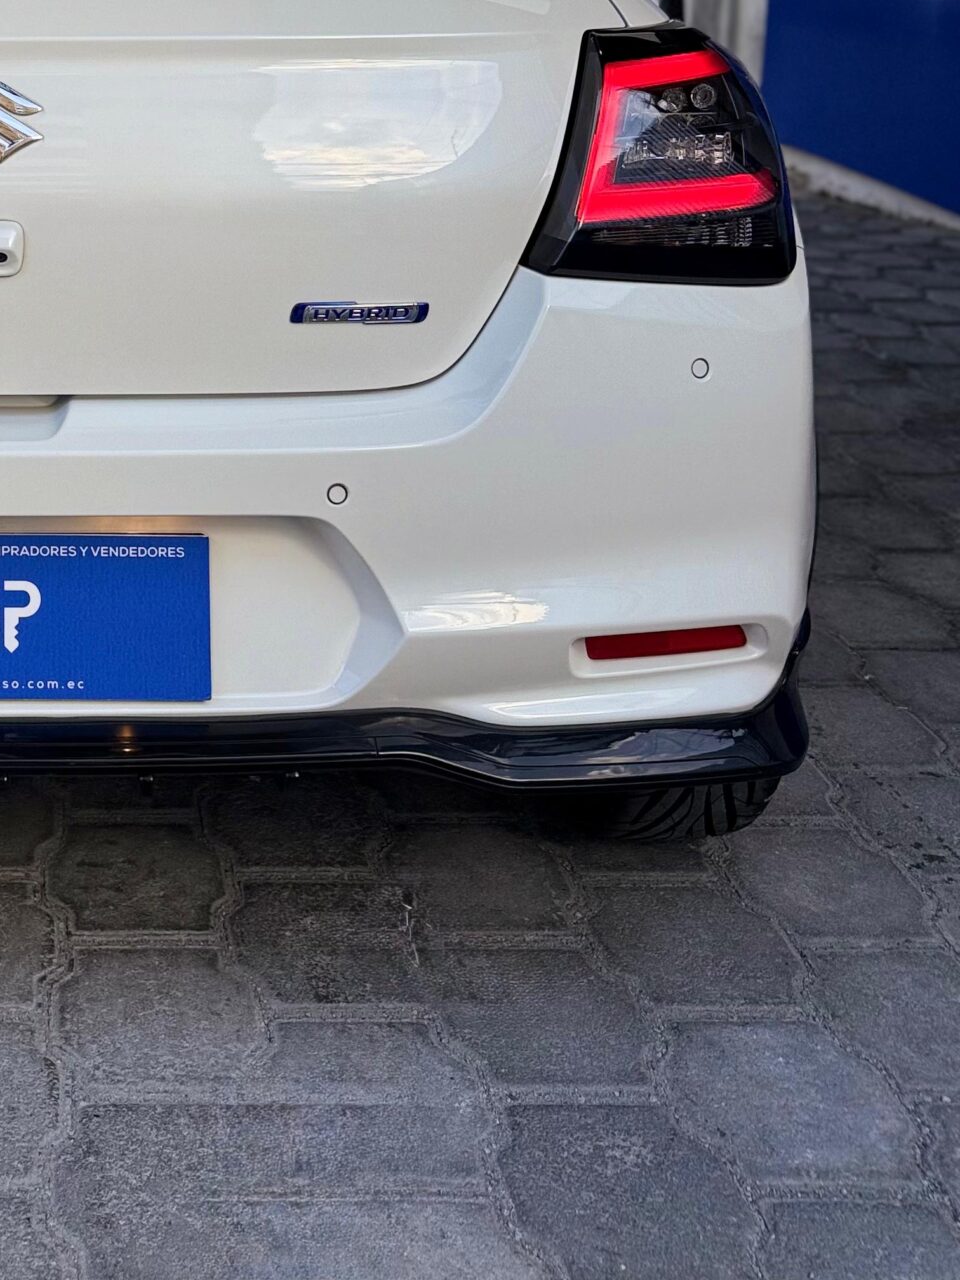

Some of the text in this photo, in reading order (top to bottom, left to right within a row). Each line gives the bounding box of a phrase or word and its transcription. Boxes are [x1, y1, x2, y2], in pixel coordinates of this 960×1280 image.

[312, 307, 410, 321] HYBRID
[79, 546, 89, 557] Y
[90, 546, 185, 558] VENDEDORES
